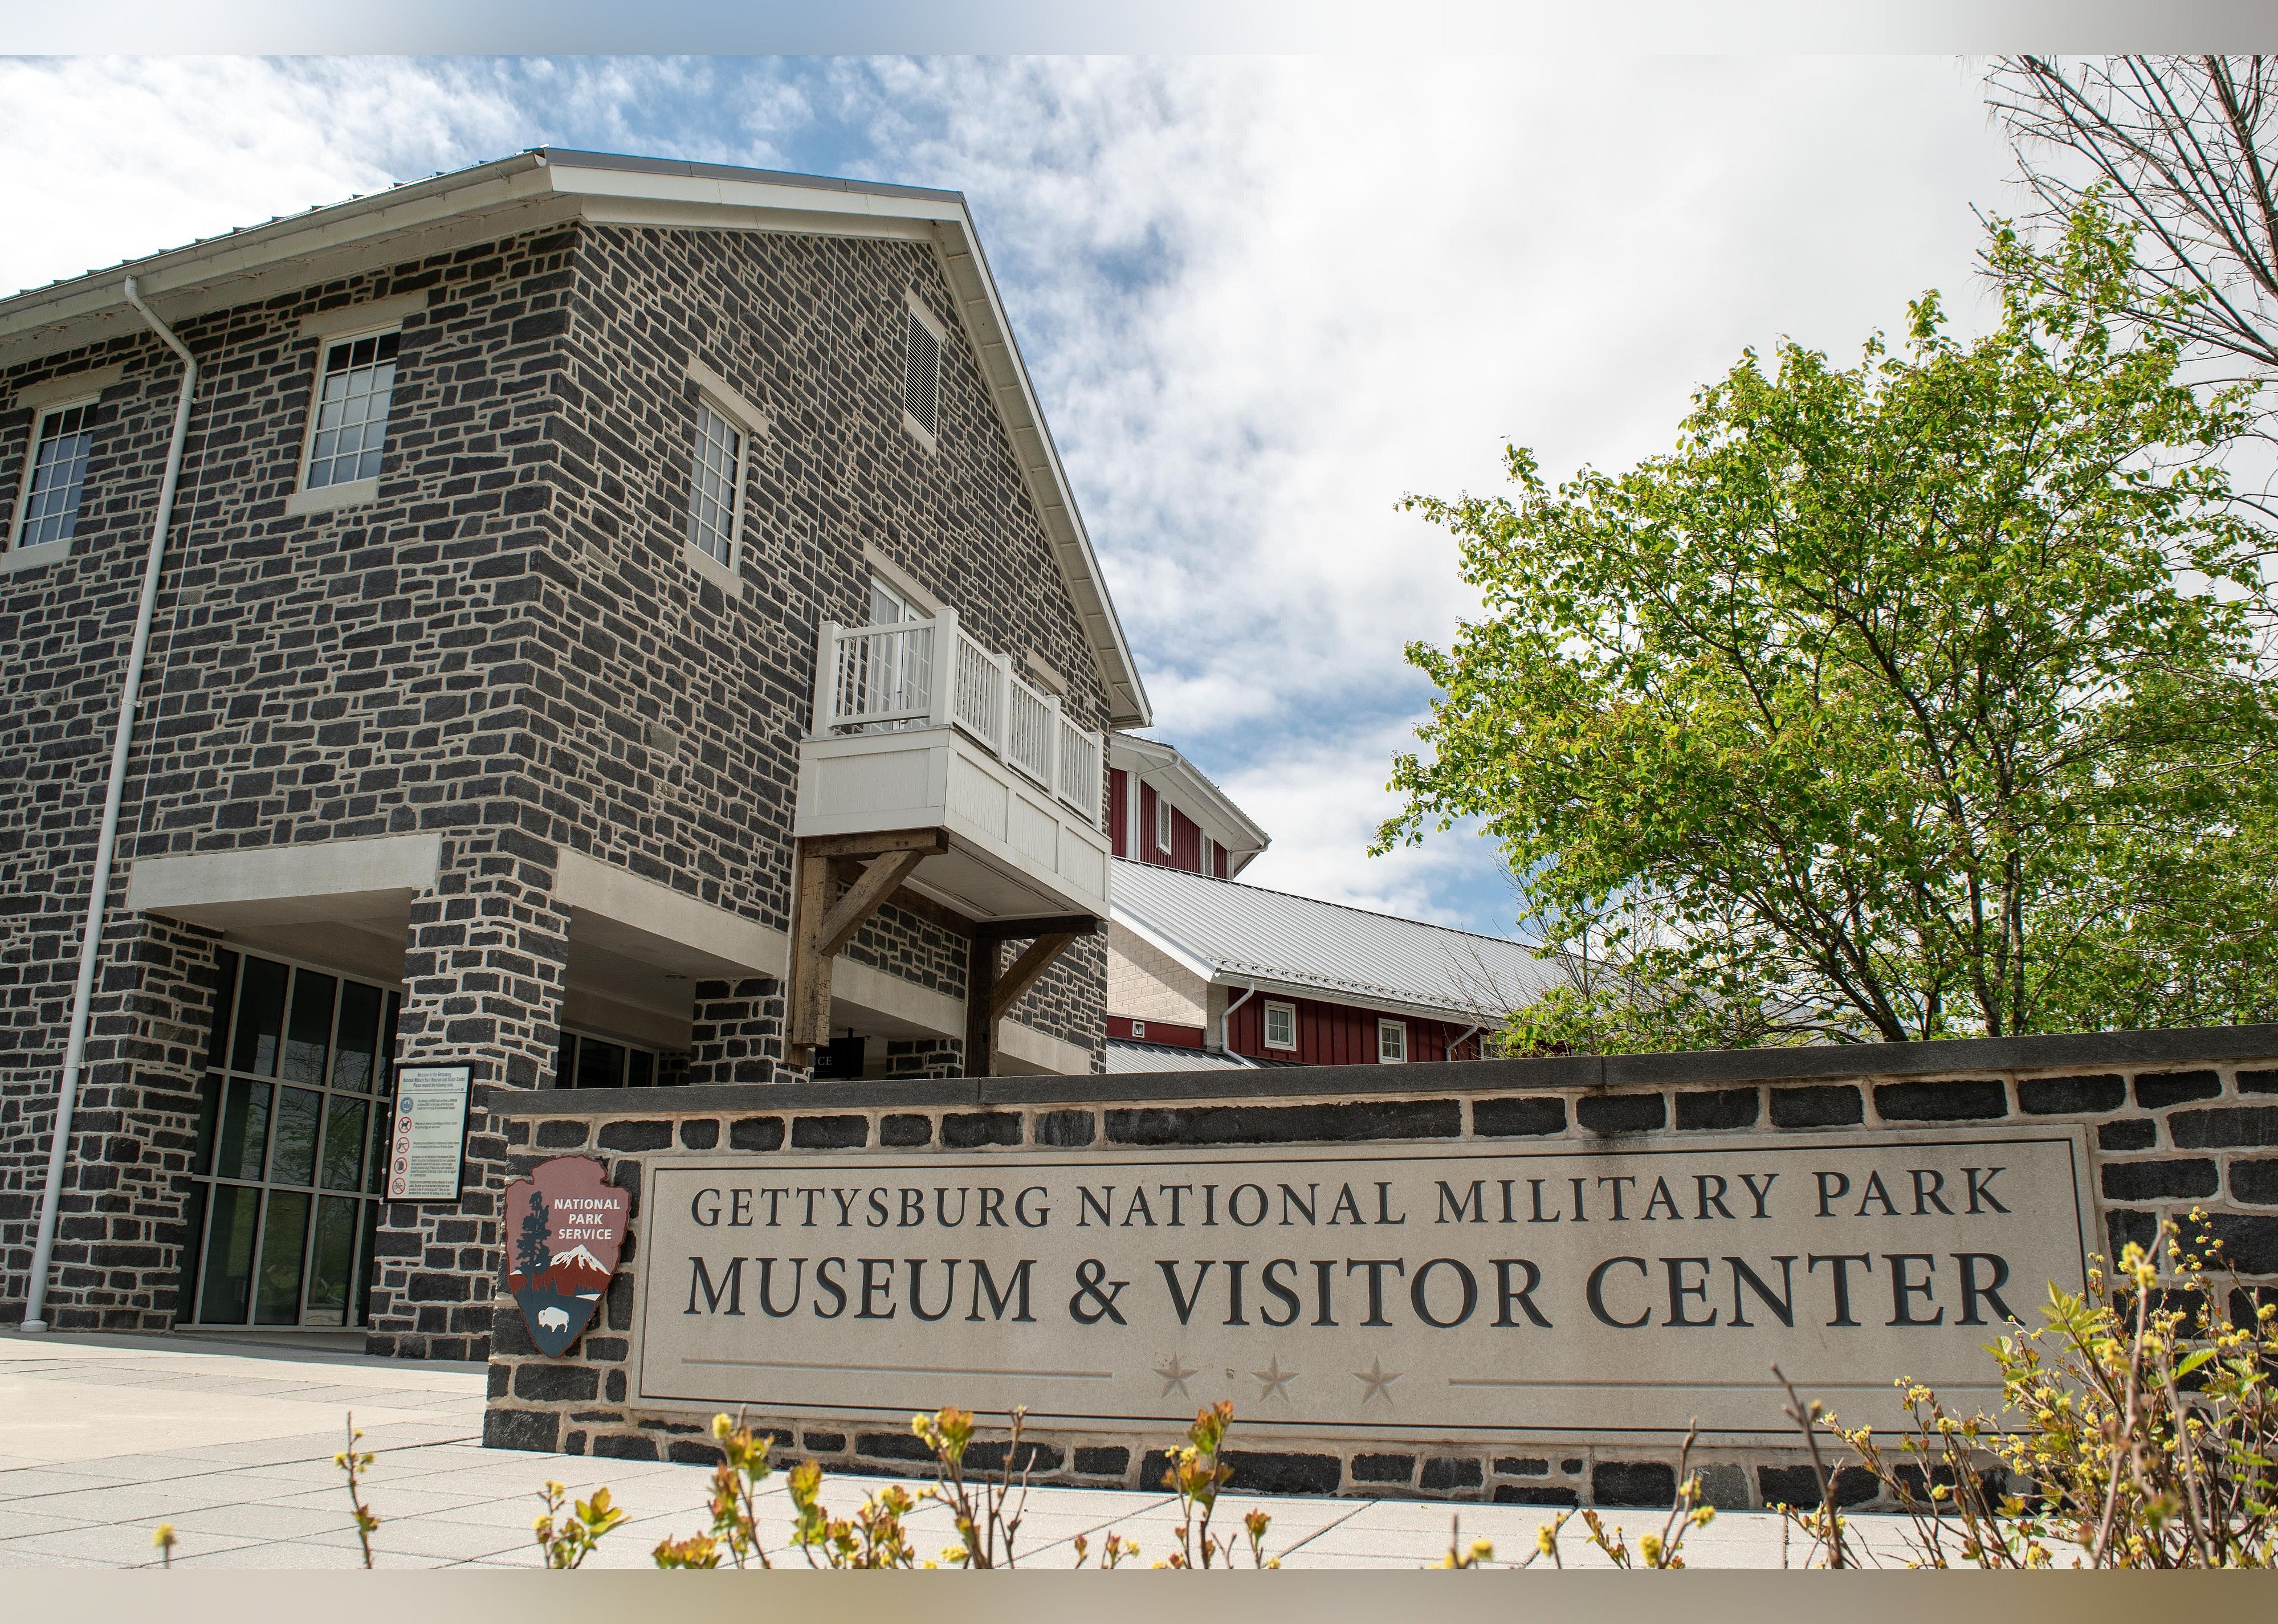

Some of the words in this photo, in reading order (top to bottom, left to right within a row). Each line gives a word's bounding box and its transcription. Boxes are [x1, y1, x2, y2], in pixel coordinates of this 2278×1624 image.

[691, 1186, 1051, 1227] GETTYSBURG
[1076, 1181, 1407, 1227] NATIONAL
[1434, 1173, 1780, 1223] MILITARY
[1812, 1167, 2011, 1217] PARK
[554, 1198, 621, 1209] NATIONAL
[569, 1213, 604, 1225] PARK
[559, 1228, 613, 1239] SERVICE
[684, 1256, 1037, 1322] MUSEUM
[1069, 1258, 1130, 1325] &
[1155, 1257, 1554, 1328] VISITOR
[1586, 1252, 2026, 1328] CENTER
